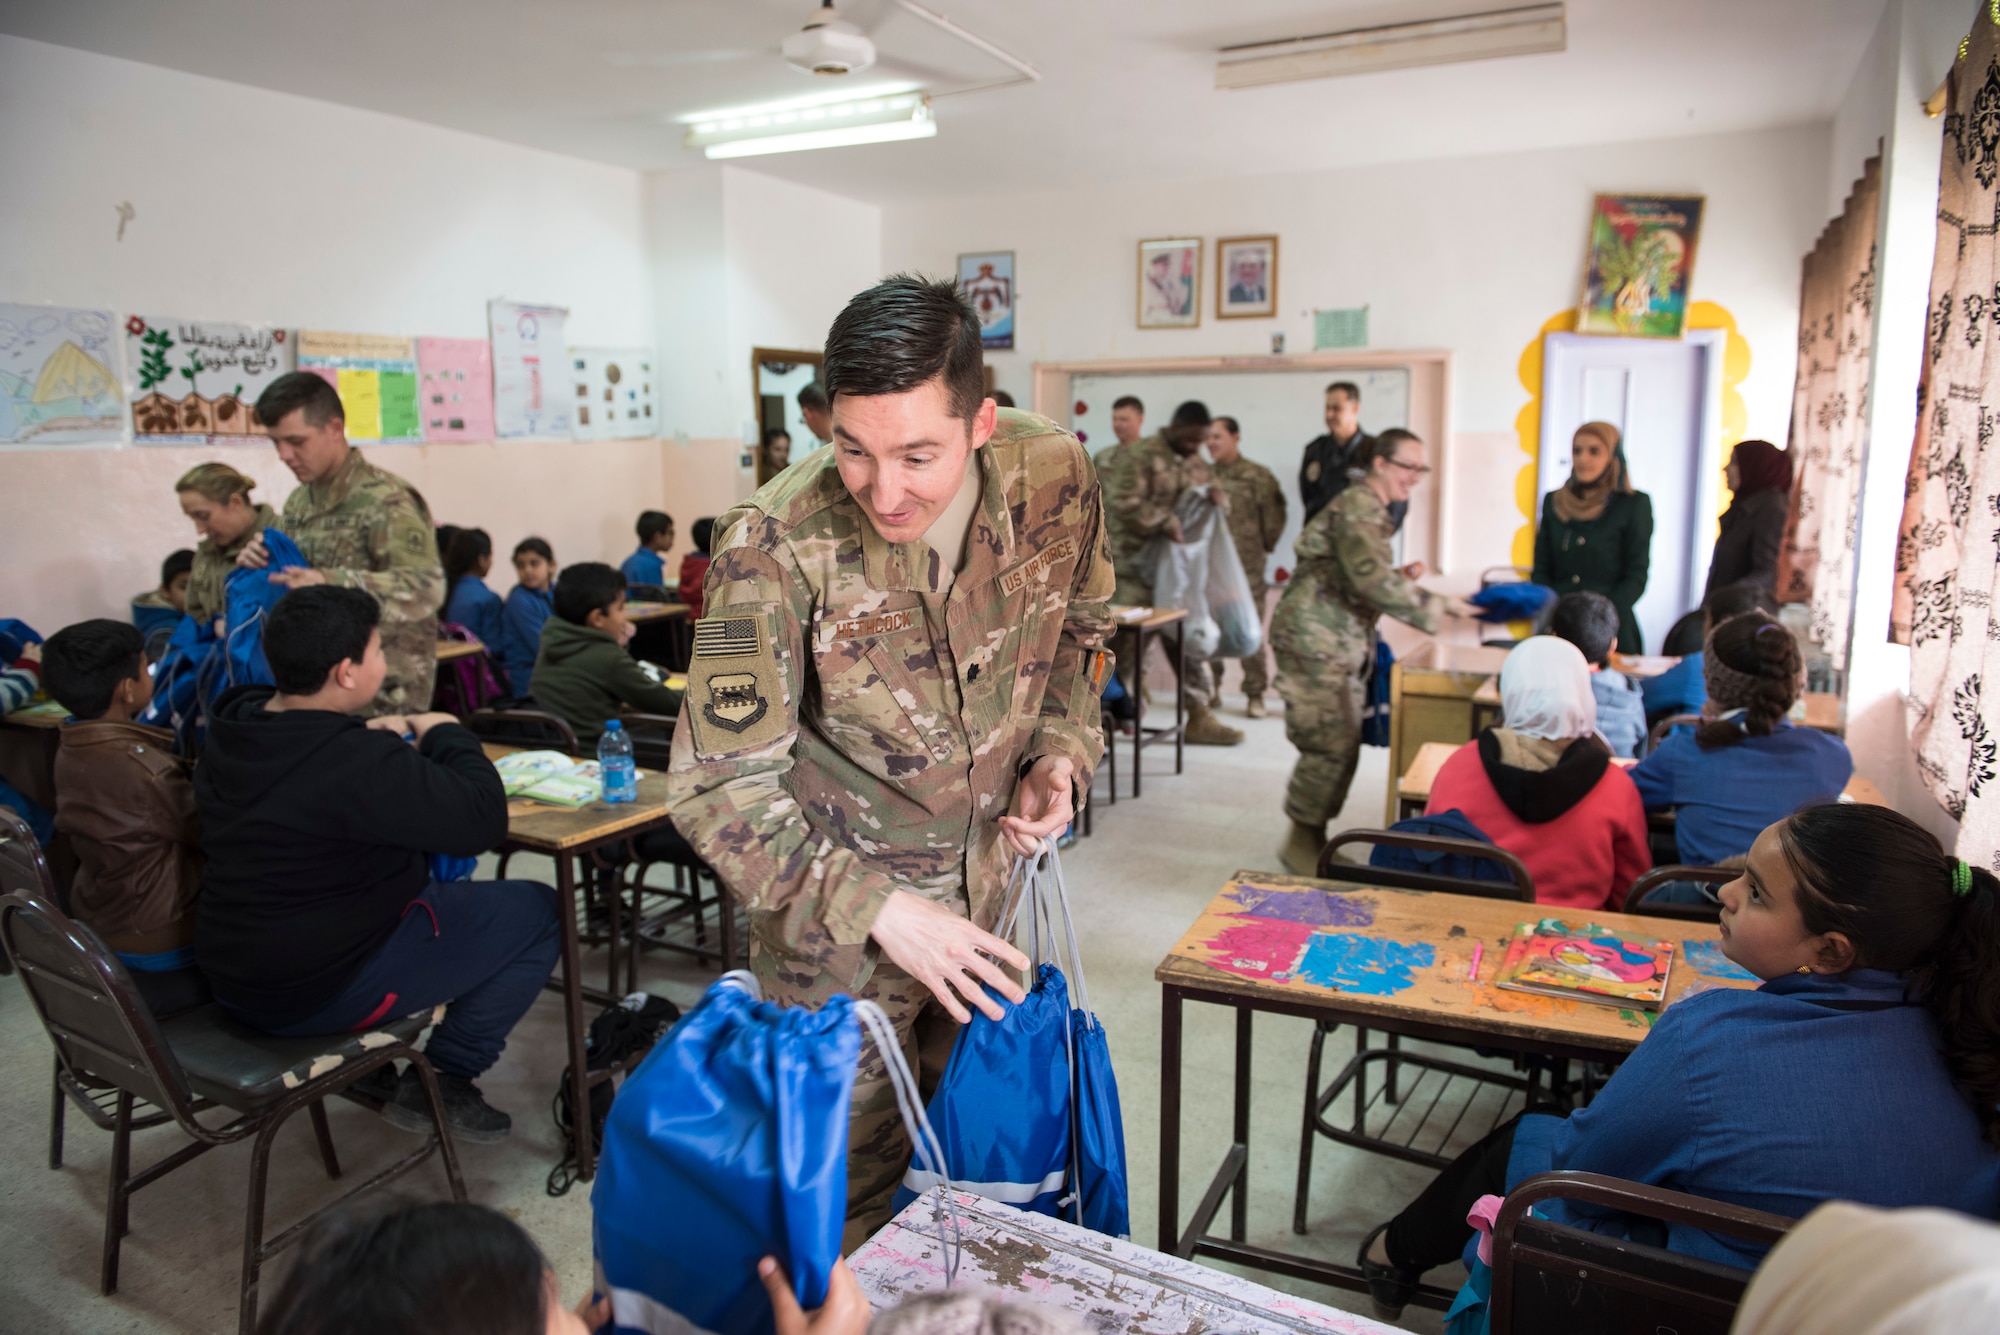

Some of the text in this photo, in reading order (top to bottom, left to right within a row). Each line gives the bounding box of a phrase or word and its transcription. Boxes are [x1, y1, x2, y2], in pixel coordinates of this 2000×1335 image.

[1024, 560, 1040, 581] AIR
[1039, 540, 1074, 569] FORCE
[836, 611, 912, 639] HETHCOCK
